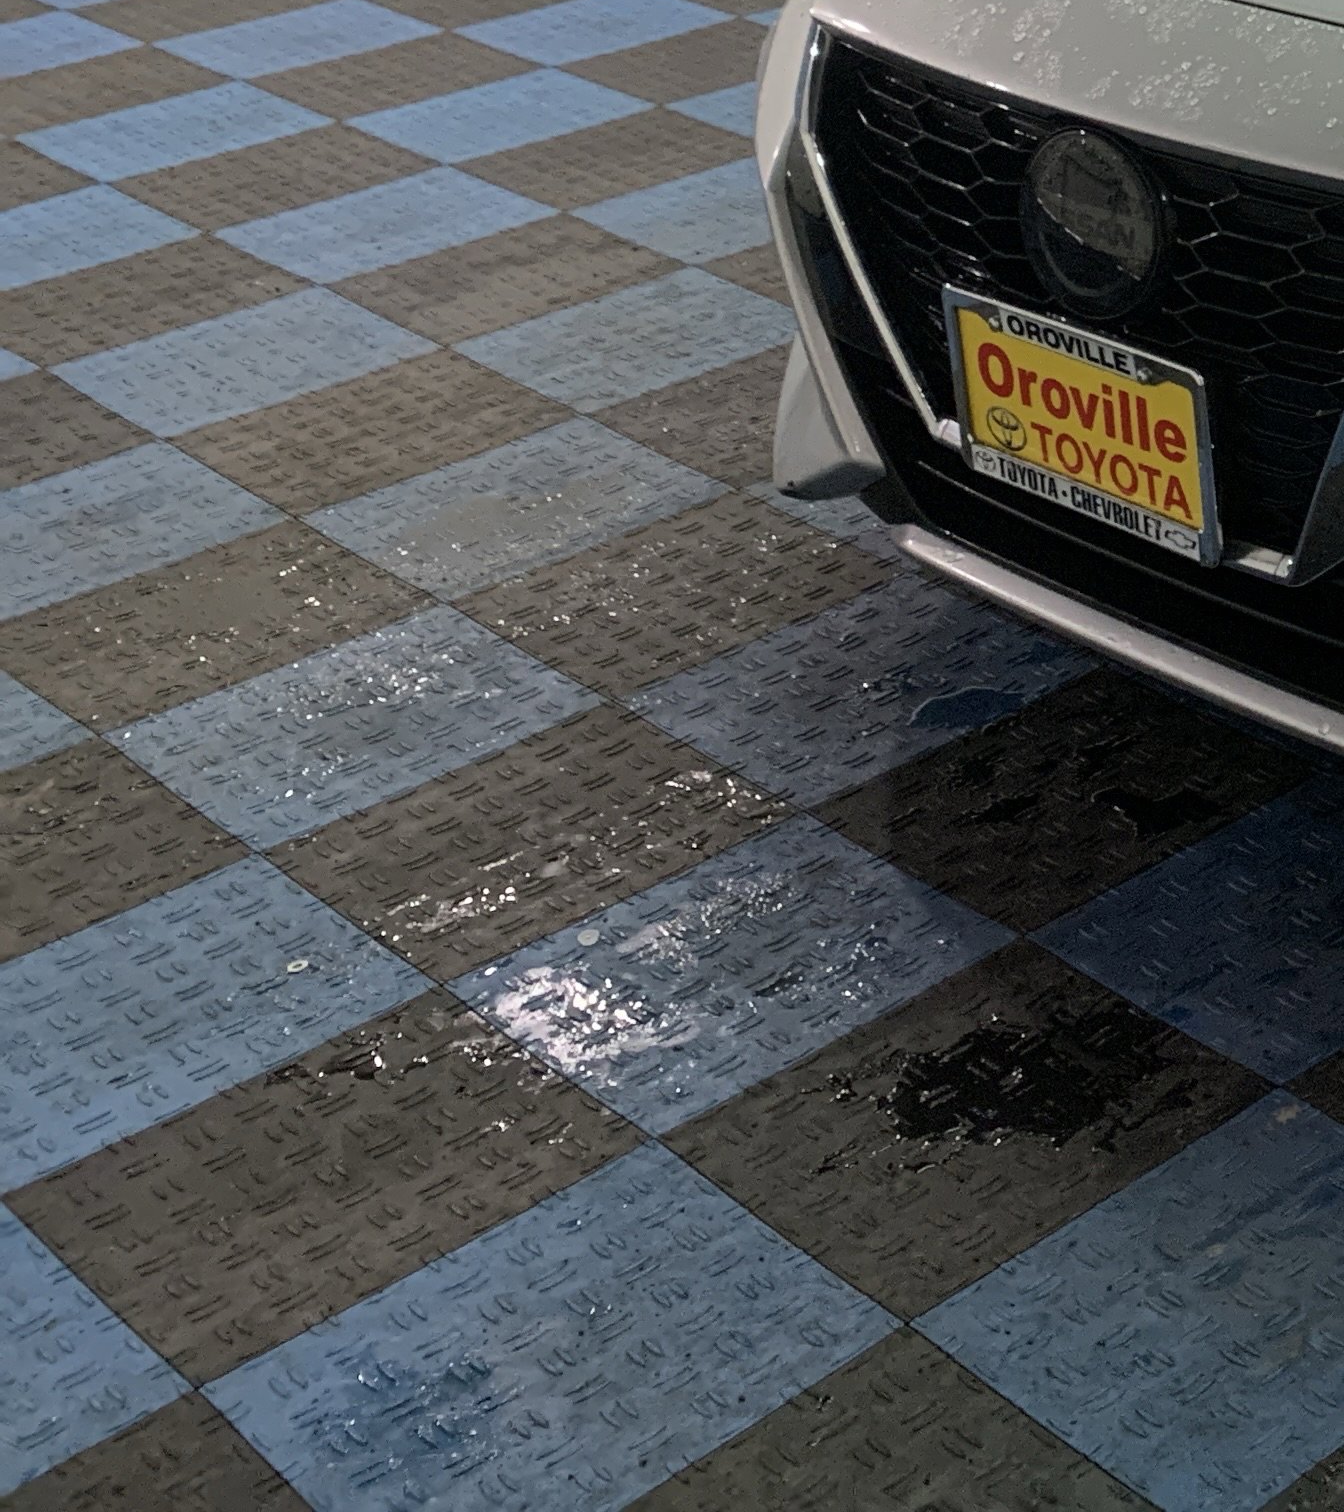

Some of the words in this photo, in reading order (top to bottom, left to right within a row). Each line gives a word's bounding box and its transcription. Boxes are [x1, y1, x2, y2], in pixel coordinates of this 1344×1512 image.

[1006, 314, 1131, 376] OROVILLE
[977, 342, 1187, 464] Oroville
[998, 454, 1058, 501] TOYOTA
[1070, 488, 1163, 542] CHEVROLET
[1031, 422, 1193, 520] TOYOTA
